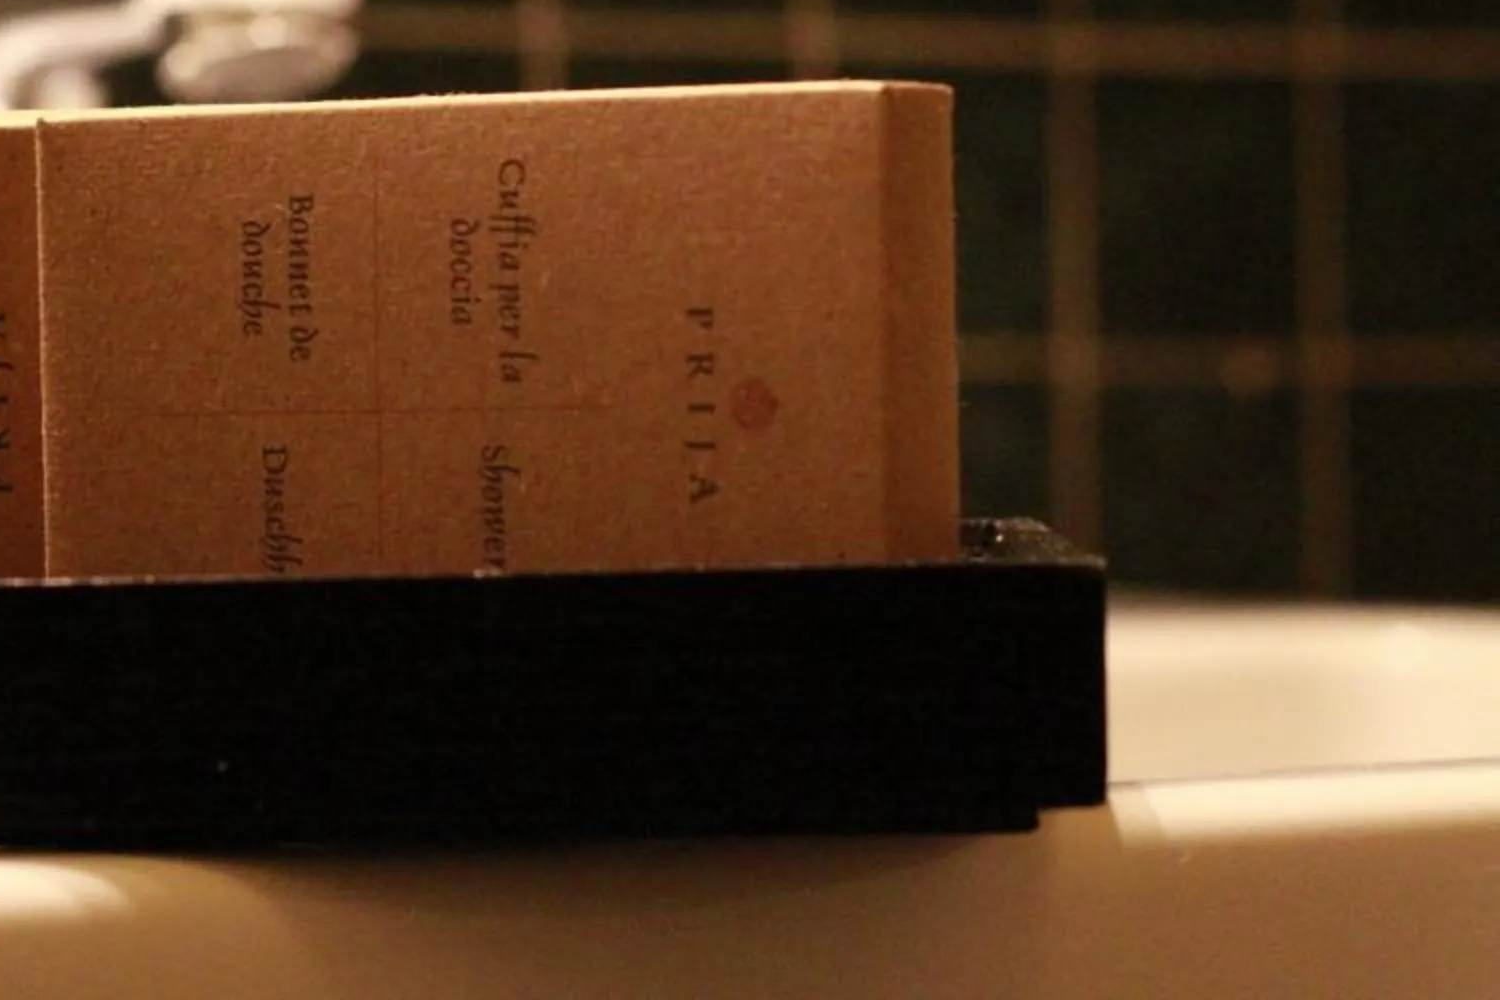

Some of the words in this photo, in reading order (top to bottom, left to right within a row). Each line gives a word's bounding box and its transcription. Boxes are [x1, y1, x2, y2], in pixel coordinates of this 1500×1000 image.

[288, 193, 315, 318] Bonnet
[489, 159, 537, 271] Cuffia
[240, 220, 281, 338] douche
[450, 218, 482, 327] doccia
[490, 274, 521, 340] per
[290, 327, 319, 362] de
[500, 350, 538, 384] la
